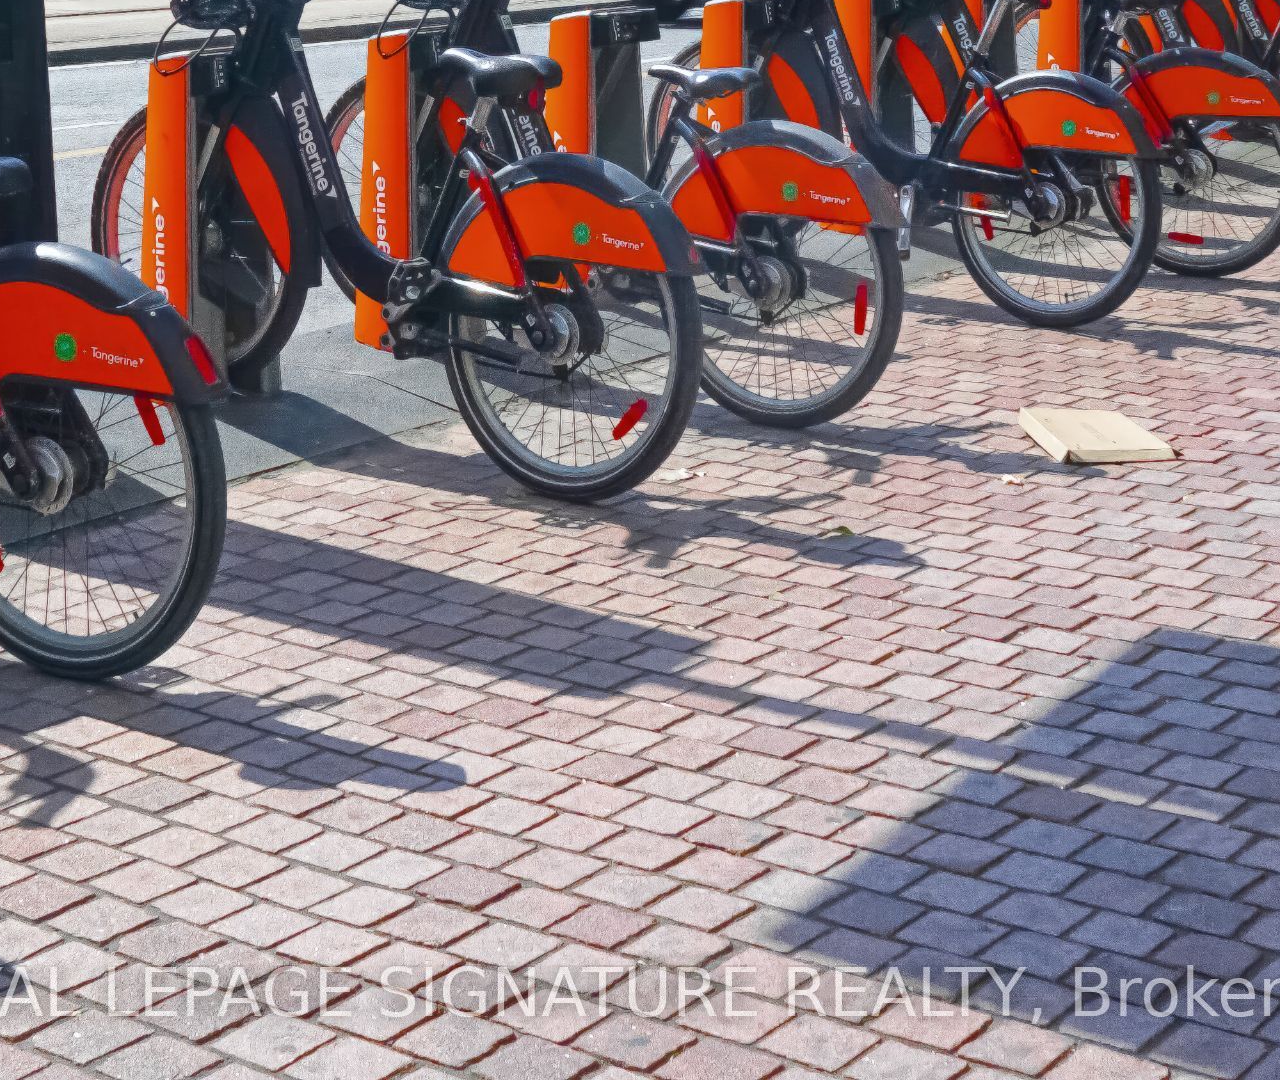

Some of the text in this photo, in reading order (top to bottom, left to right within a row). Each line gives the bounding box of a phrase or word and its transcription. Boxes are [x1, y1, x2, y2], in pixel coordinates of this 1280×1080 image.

[1159, 9, 1177, 39] erine
[825, 28, 854, 101] Tangerine
[291, 91, 328, 192] Tangerine
[518, 115, 542, 156] erine
[372, 176, 391, 255] gerine
[810, 190, 846, 206] Tangerine
[152, 213, 169, 301] gerine
[602, 233, 640, 251] Tangerine
[91, 346, 138, 368] Tangerine
